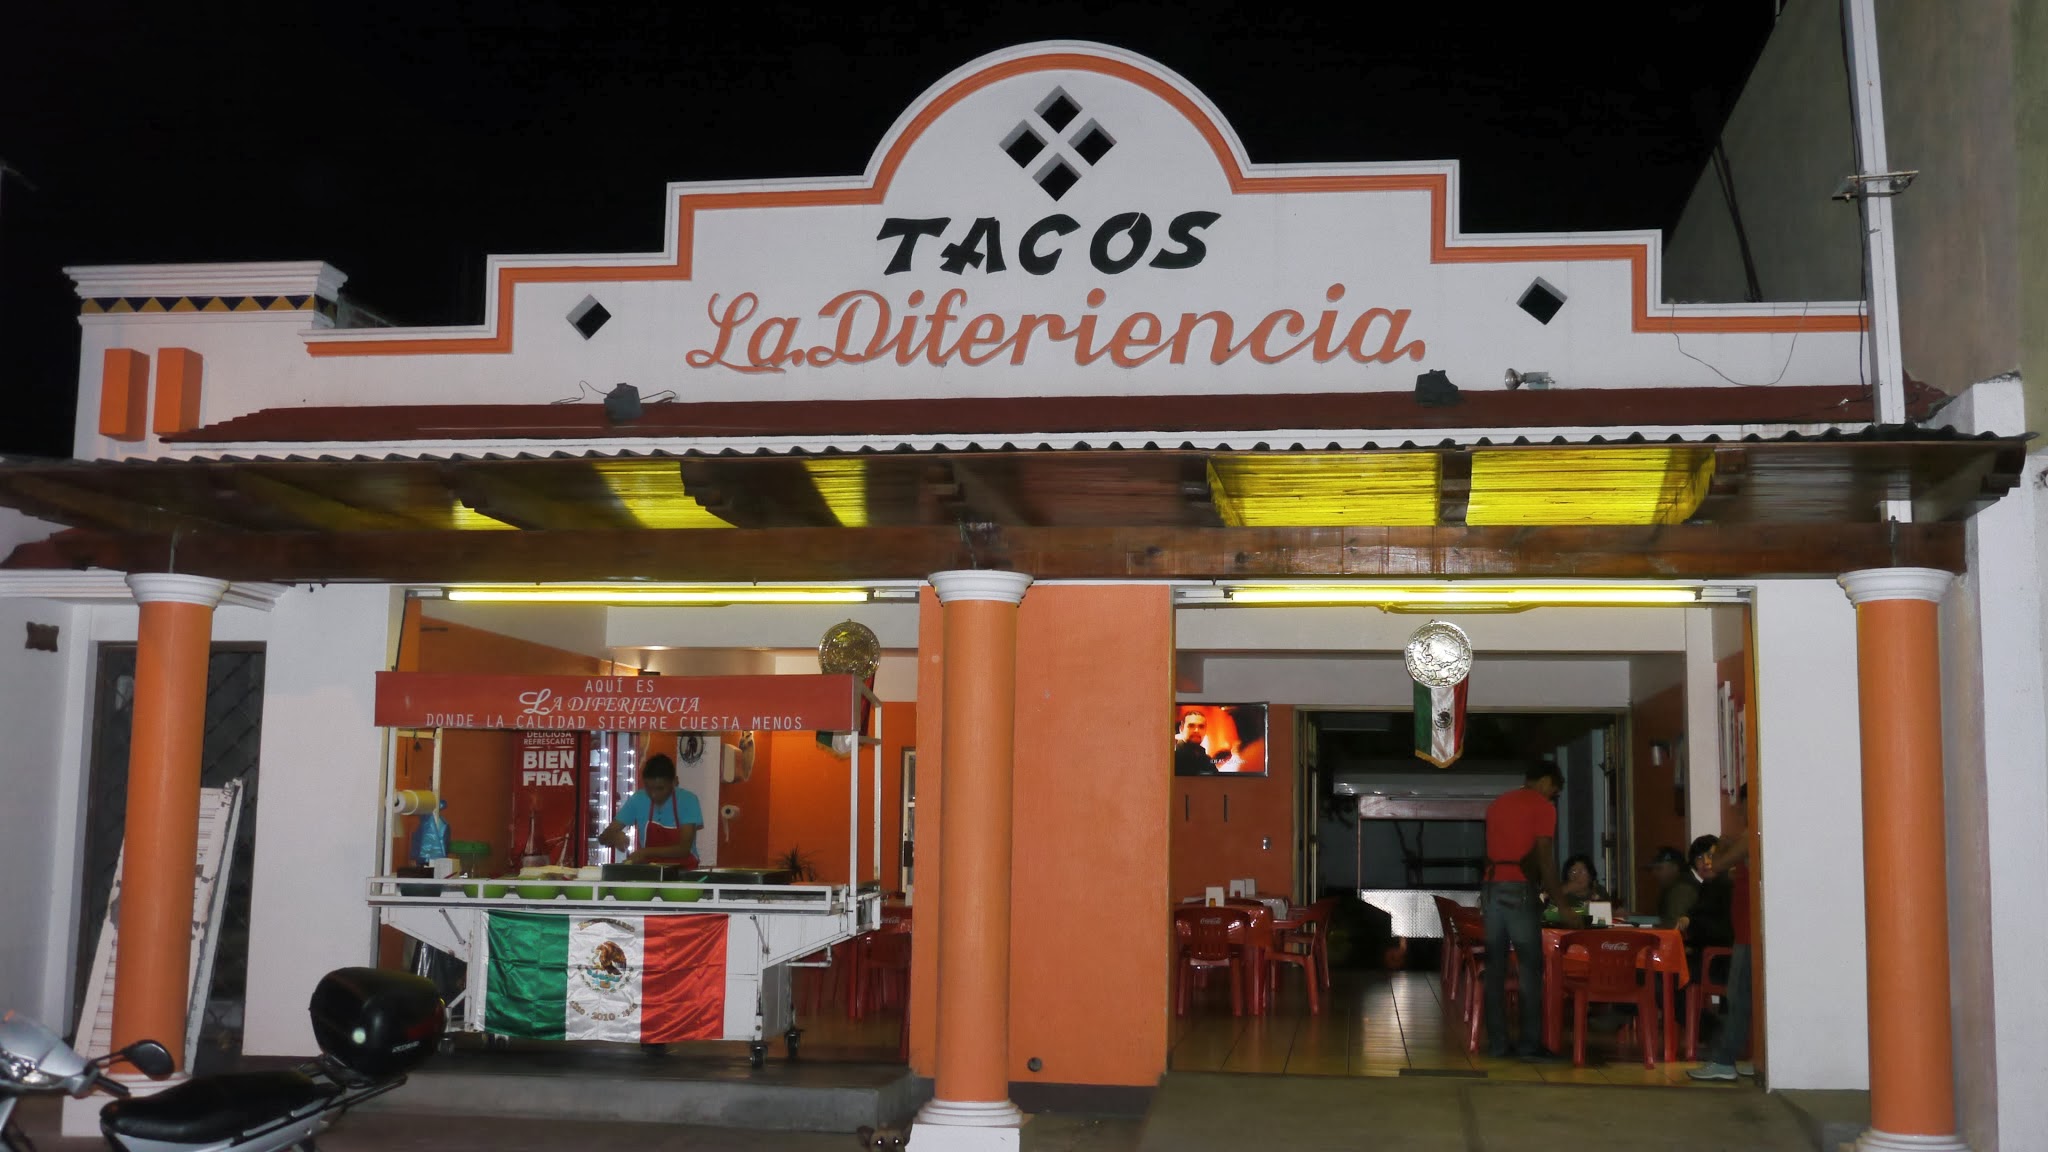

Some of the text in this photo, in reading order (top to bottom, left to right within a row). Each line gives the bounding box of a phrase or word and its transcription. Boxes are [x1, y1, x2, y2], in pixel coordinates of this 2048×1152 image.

[876, 210, 1222, 275] TACOS
[806, 283, 1426, 369] Diferiencia
[584, 677, 654, 693] AQUÍ ES
[567, 696, 700, 714] DIFERIENCIA
[426, 713, 802, 730] DONDE LA CALIDAD SIEMPRE CUESTA MENOS
[523, 750, 575, 769] BIEN
[590, 1011, 616, 1021] 2010
